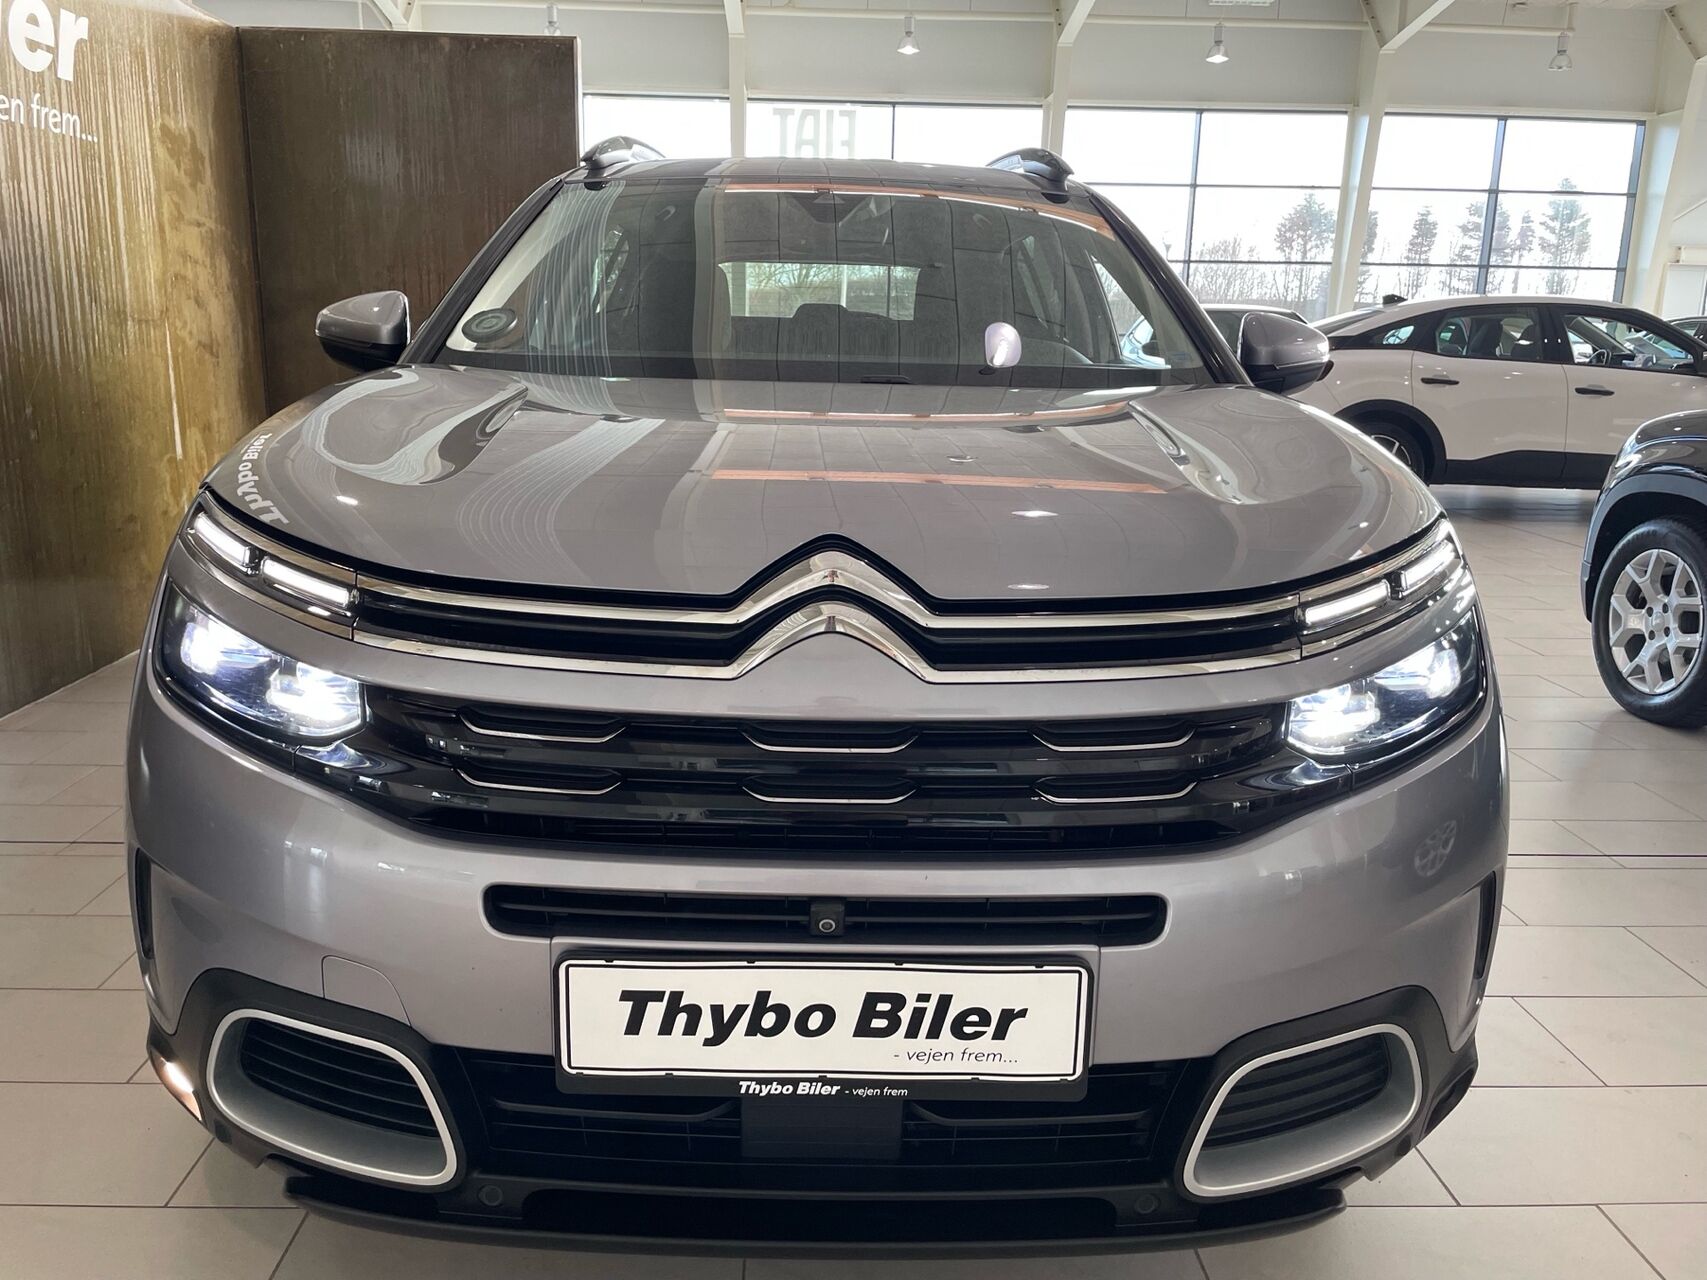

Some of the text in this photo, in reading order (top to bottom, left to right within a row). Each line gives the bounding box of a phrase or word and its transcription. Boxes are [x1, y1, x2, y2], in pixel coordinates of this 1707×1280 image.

[31, 93, 98, 143] frem...
[618, 990, 1029, 1047] Thybo Biler
[906, 1049, 955, 1064] vejen
[959, 1048, 1018, 1063] frem...
[739, 1081, 794, 1097] Thybo
[797, 1082, 840, 1096] Biler
[852, 1086, 880, 1098] vejen
[883, 1086, 908, 1096] frem
